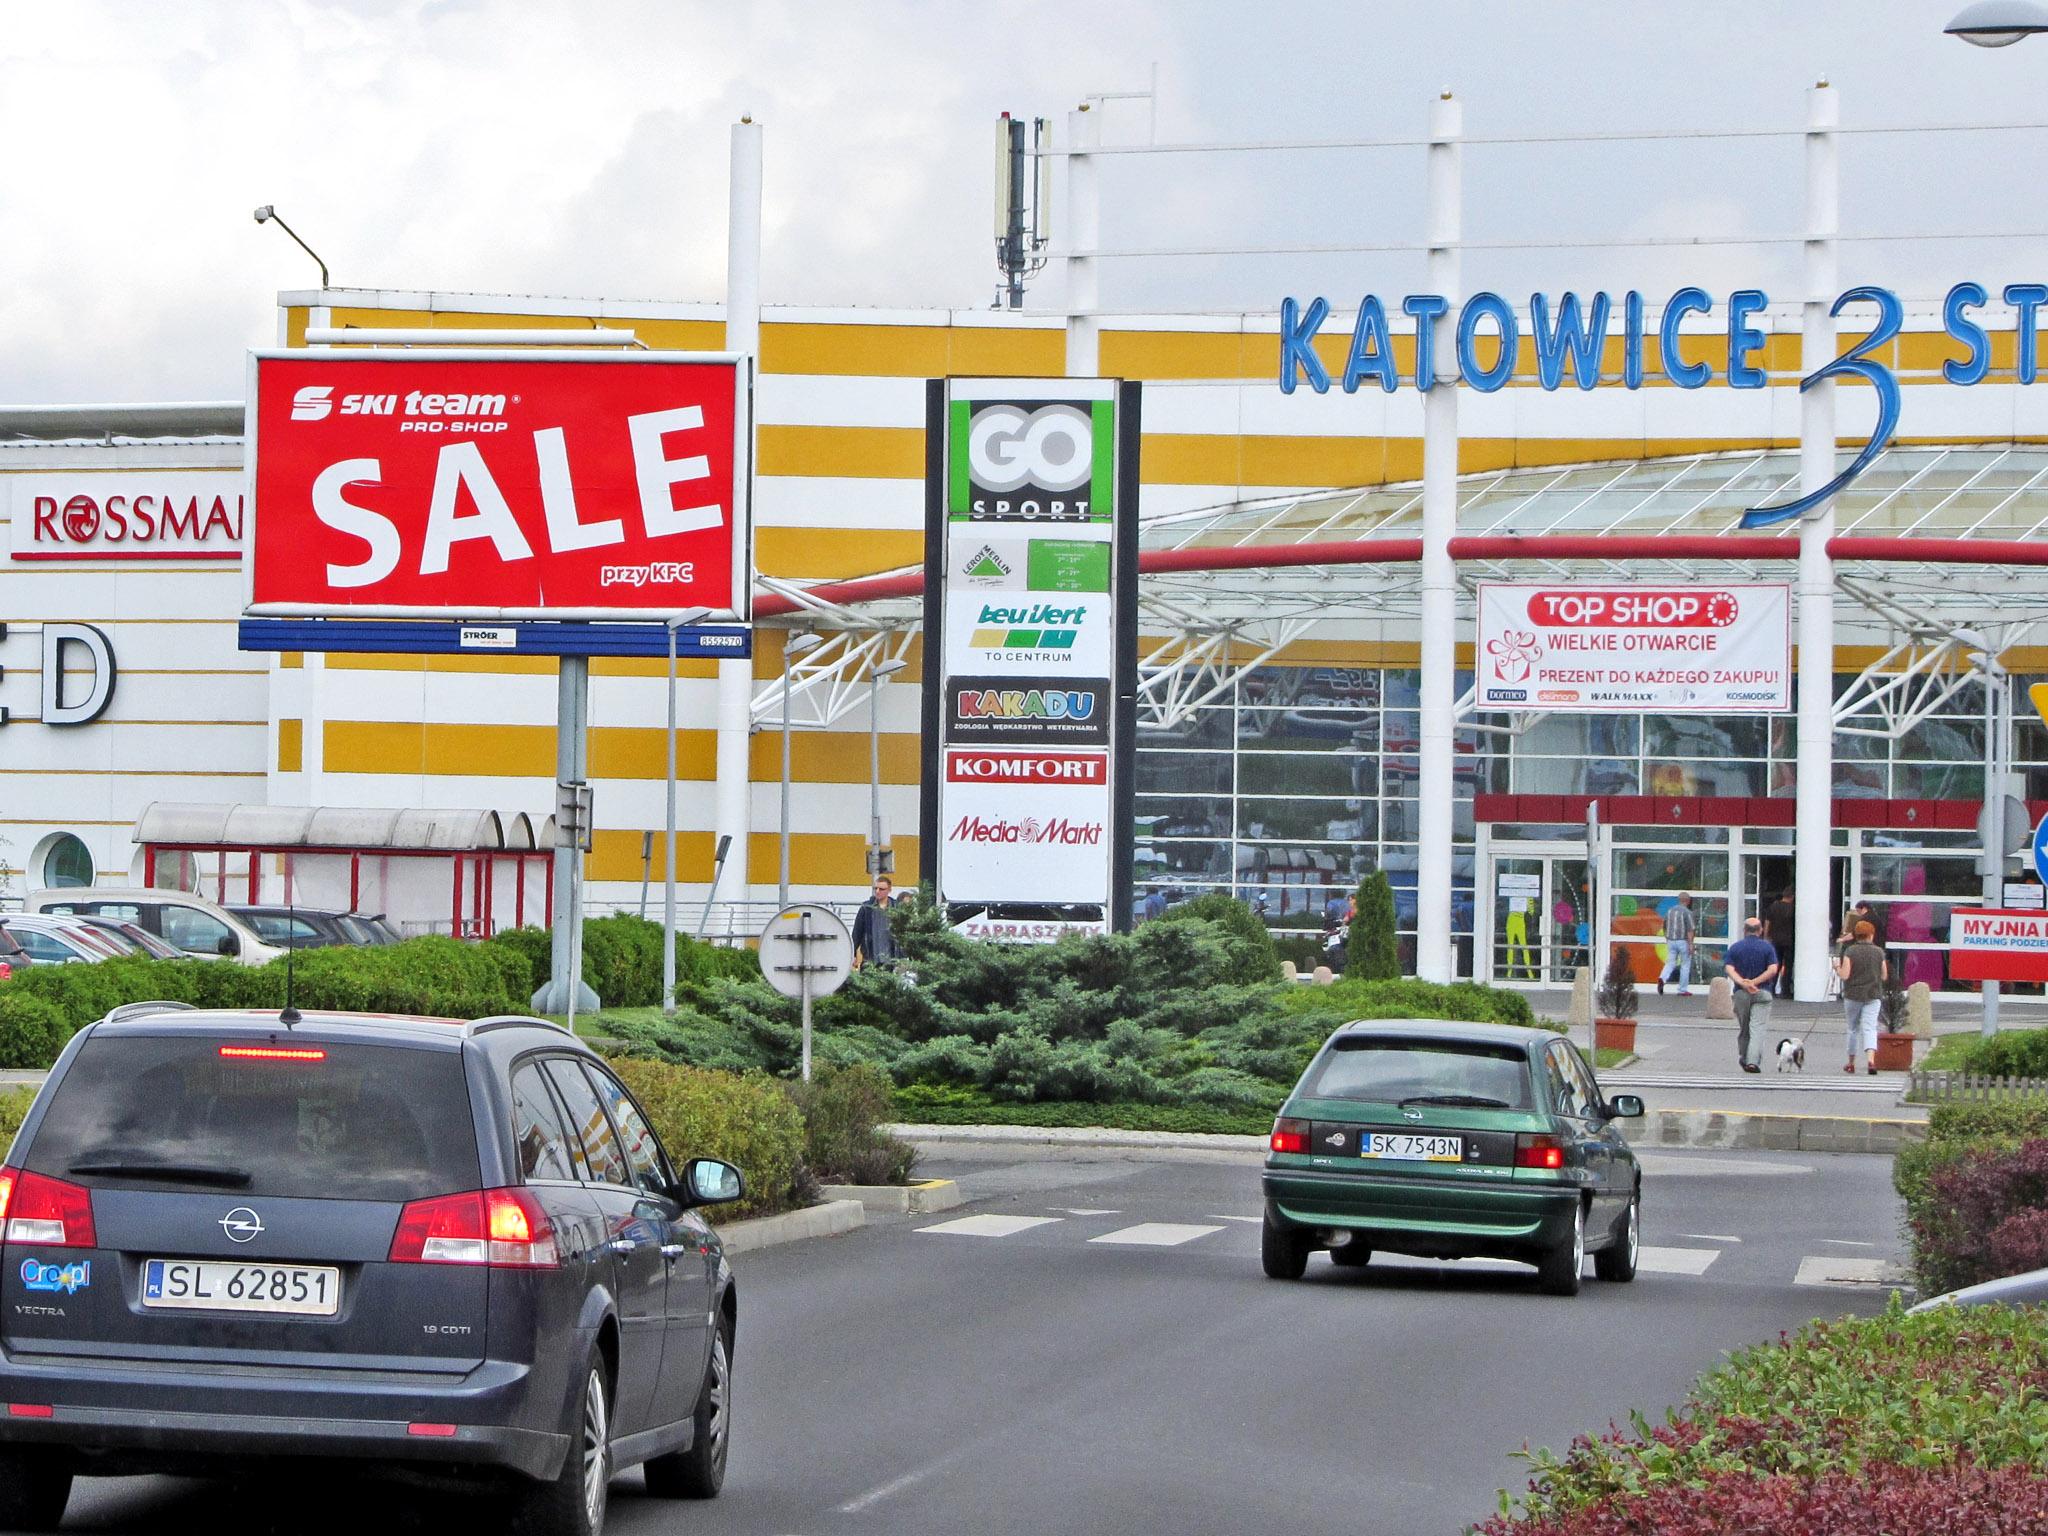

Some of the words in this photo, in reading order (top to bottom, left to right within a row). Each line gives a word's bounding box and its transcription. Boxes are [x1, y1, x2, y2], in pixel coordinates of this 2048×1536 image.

[340, 393, 397, 416] SKI
[404, 390, 506, 417] team
[1280, 287, 1769, 395] KATOWICE
[1738, 286, 1905, 530] 3
[1943, 282, 2048, 386] ST
[969, 412, 1093, 486] GO
[312, 405, 724, 588] SALE
[972, 500, 1089, 520] SPORT
[962, 550, 986, 576] LEROY
[983, 544, 1012, 576] MERLIN
[601, 565, 648, 586] przy
[651, 562, 694, 583] KFC
[1543, 596, 1605, 624] TOP
[1612, 596, 1699, 624] SHOP
[701, 636, 743, 647] 8552570
[1547, 634, 1617, 651] WIELKIE
[1622, 634, 1717, 651] OTWARCIE
[985, 652, 1002, 661] TO
[1005, 652, 1072, 662] CENTRUM
[0, 622, 117, 727] D
[1538, 669, 1604, 683] PREZENT
[1609, 670, 1631, 684] DO
[1635, 667, 1710, 684] KAŻDEGO
[1713, 670, 1779, 684] ZAKUPU!
[958, 690, 1095, 720] KAKADU
[992, 724, 1043, 732] WĘDKARSTWO
[955, 758, 1100, 778] KOMFORT
[949, 815, 1020, 843] Media
[1035, 818, 1103, 845] Markt
[1963, 920, 2039, 937] MYJNIA
[1963, 936, 2007, 946] PARKING
[2010, 938, 2048, 948] PODZIE
[1373, 1135, 1397, 1153] SK
[1404, 1137, 1459, 1156] 7543N
[148, 1284, 161, 1294] PL
[168, 1265, 212, 1298] SL
[227, 1267, 326, 1304] 62851
[14, 1305, 66, 1316] VECTRA
[440, 1325, 471, 1334] CDTI
